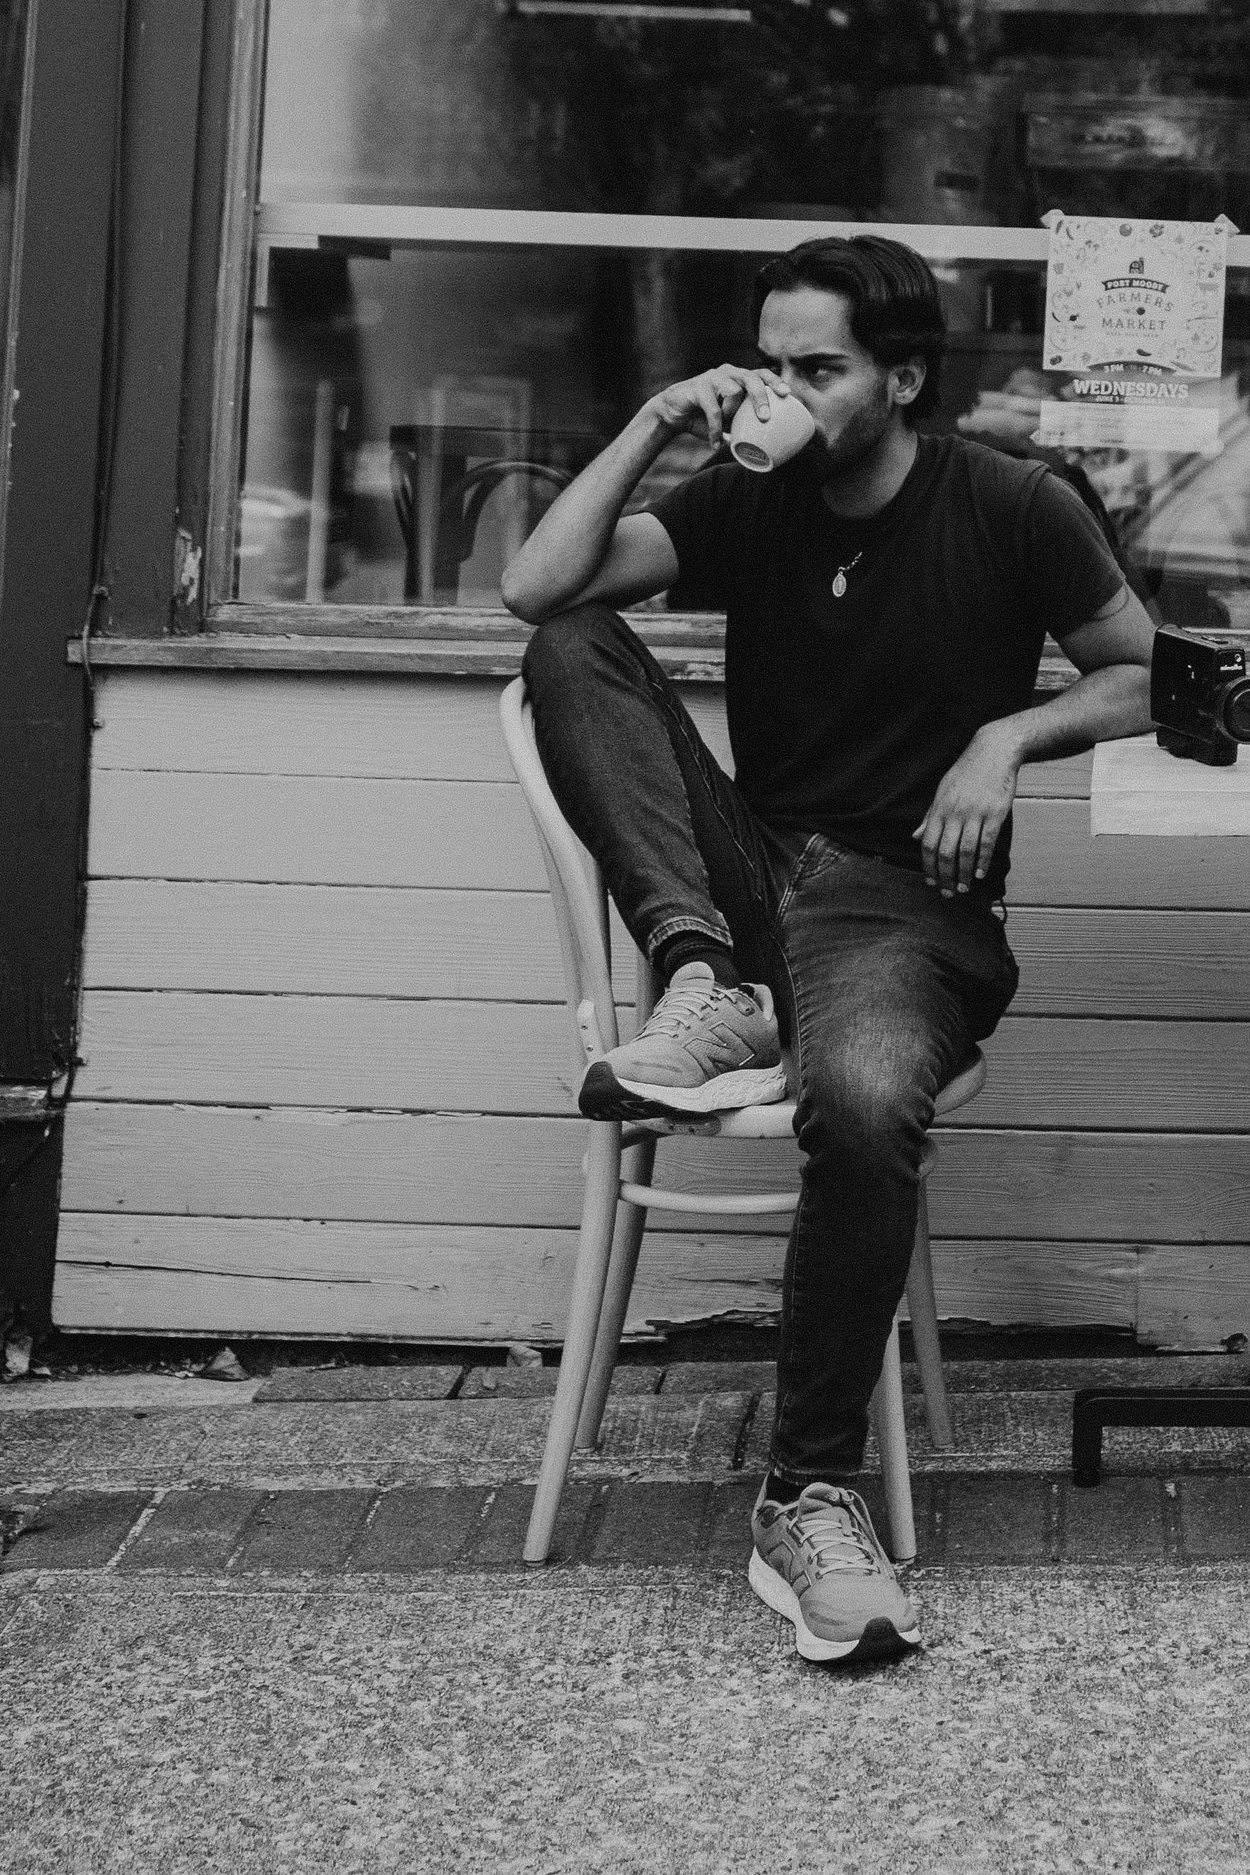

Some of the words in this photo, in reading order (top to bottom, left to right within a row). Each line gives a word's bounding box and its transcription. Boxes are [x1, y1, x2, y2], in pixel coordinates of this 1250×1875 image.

[1096, 292, 1174, 312] FARMERS
[1101, 317, 1166, 330] MARKET
[1073, 378, 1189, 399] WEDNESDAYS
